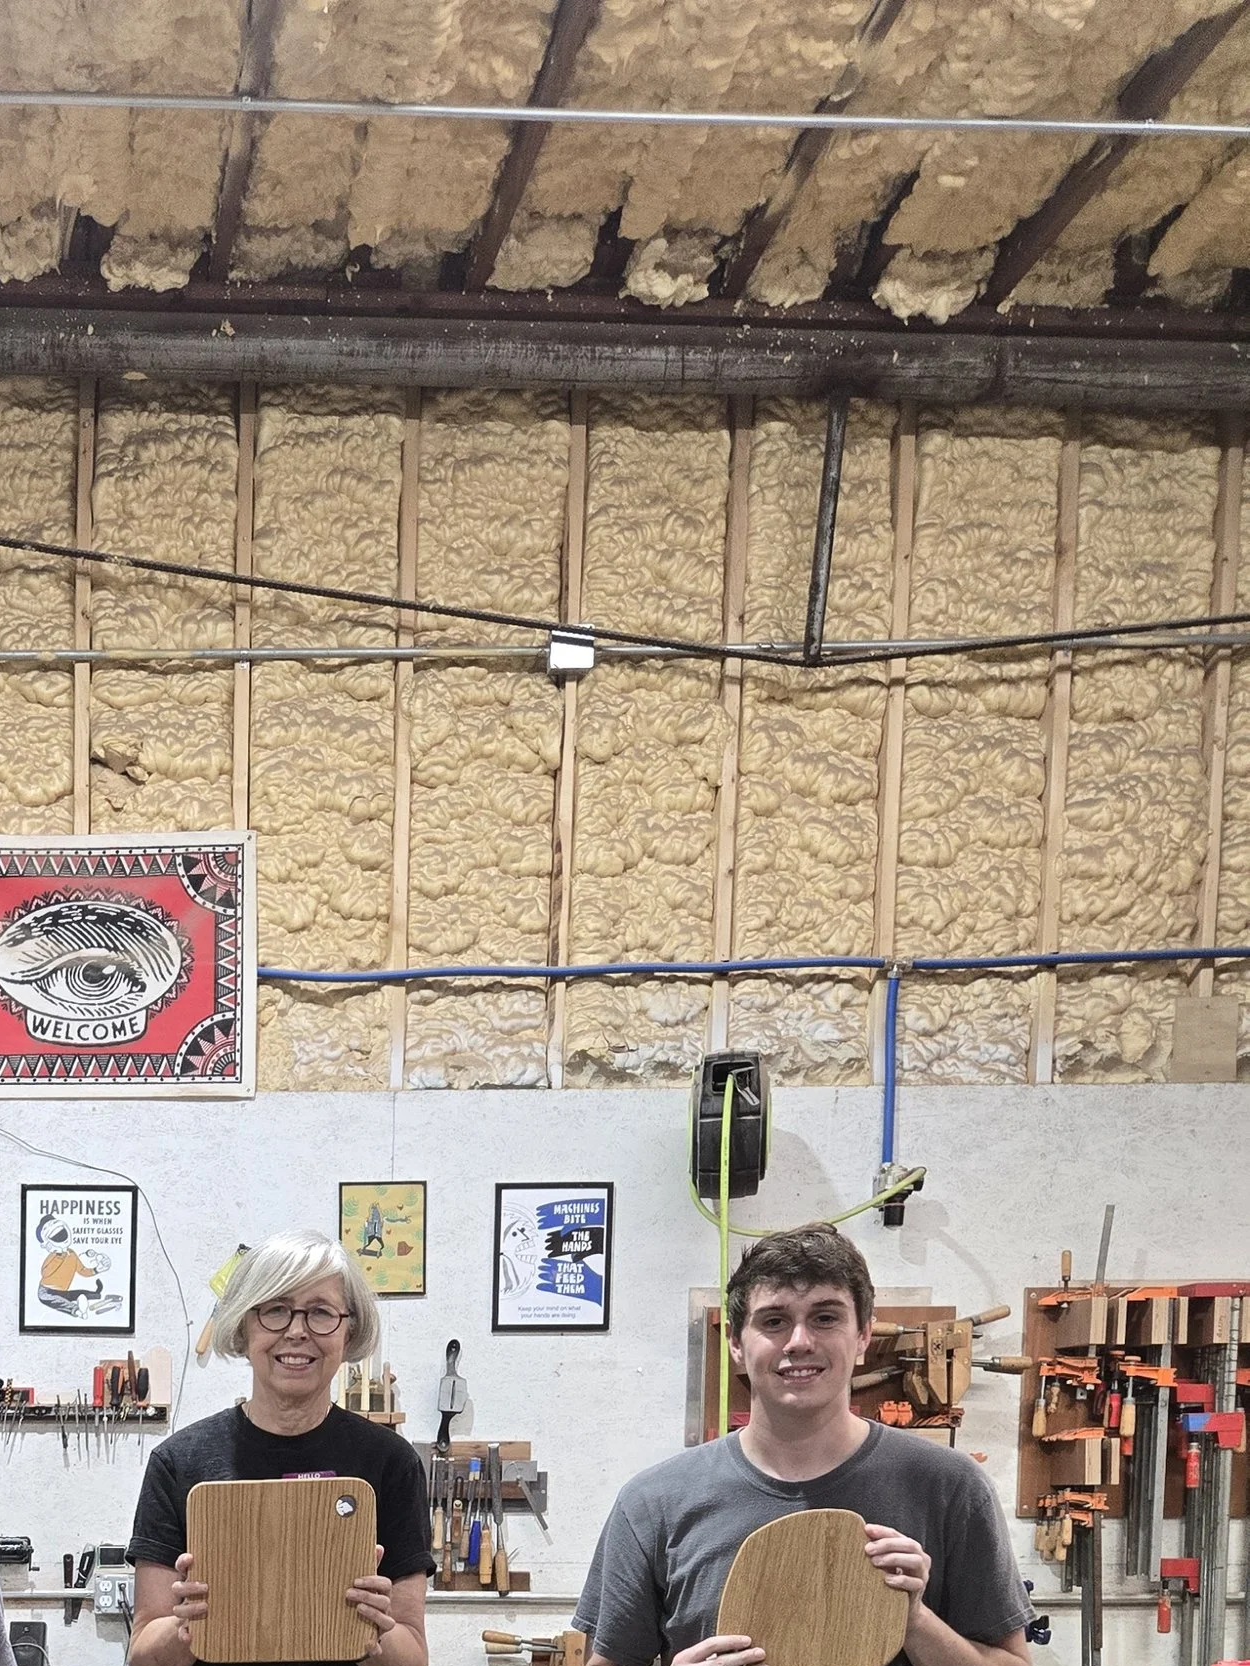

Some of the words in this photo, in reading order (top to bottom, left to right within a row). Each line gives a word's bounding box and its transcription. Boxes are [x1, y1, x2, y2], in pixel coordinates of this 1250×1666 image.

[33, 1016, 141, 1041] WELCOME
[40, 1200, 121, 1215] HAPPINESS
[553, 1203, 600, 1214] MACHINES
[564, 1214, 586, 1224] BITE
[572, 1231, 590, 1241] THE
[562, 1241, 592, 1252] HANDS
[557, 1263, 584, 1273] THAT
[555, 1273, 584, 1284] FEED
[556, 1284, 585, 1294] THEM
[298, 1472, 321, 1480] HELLO
